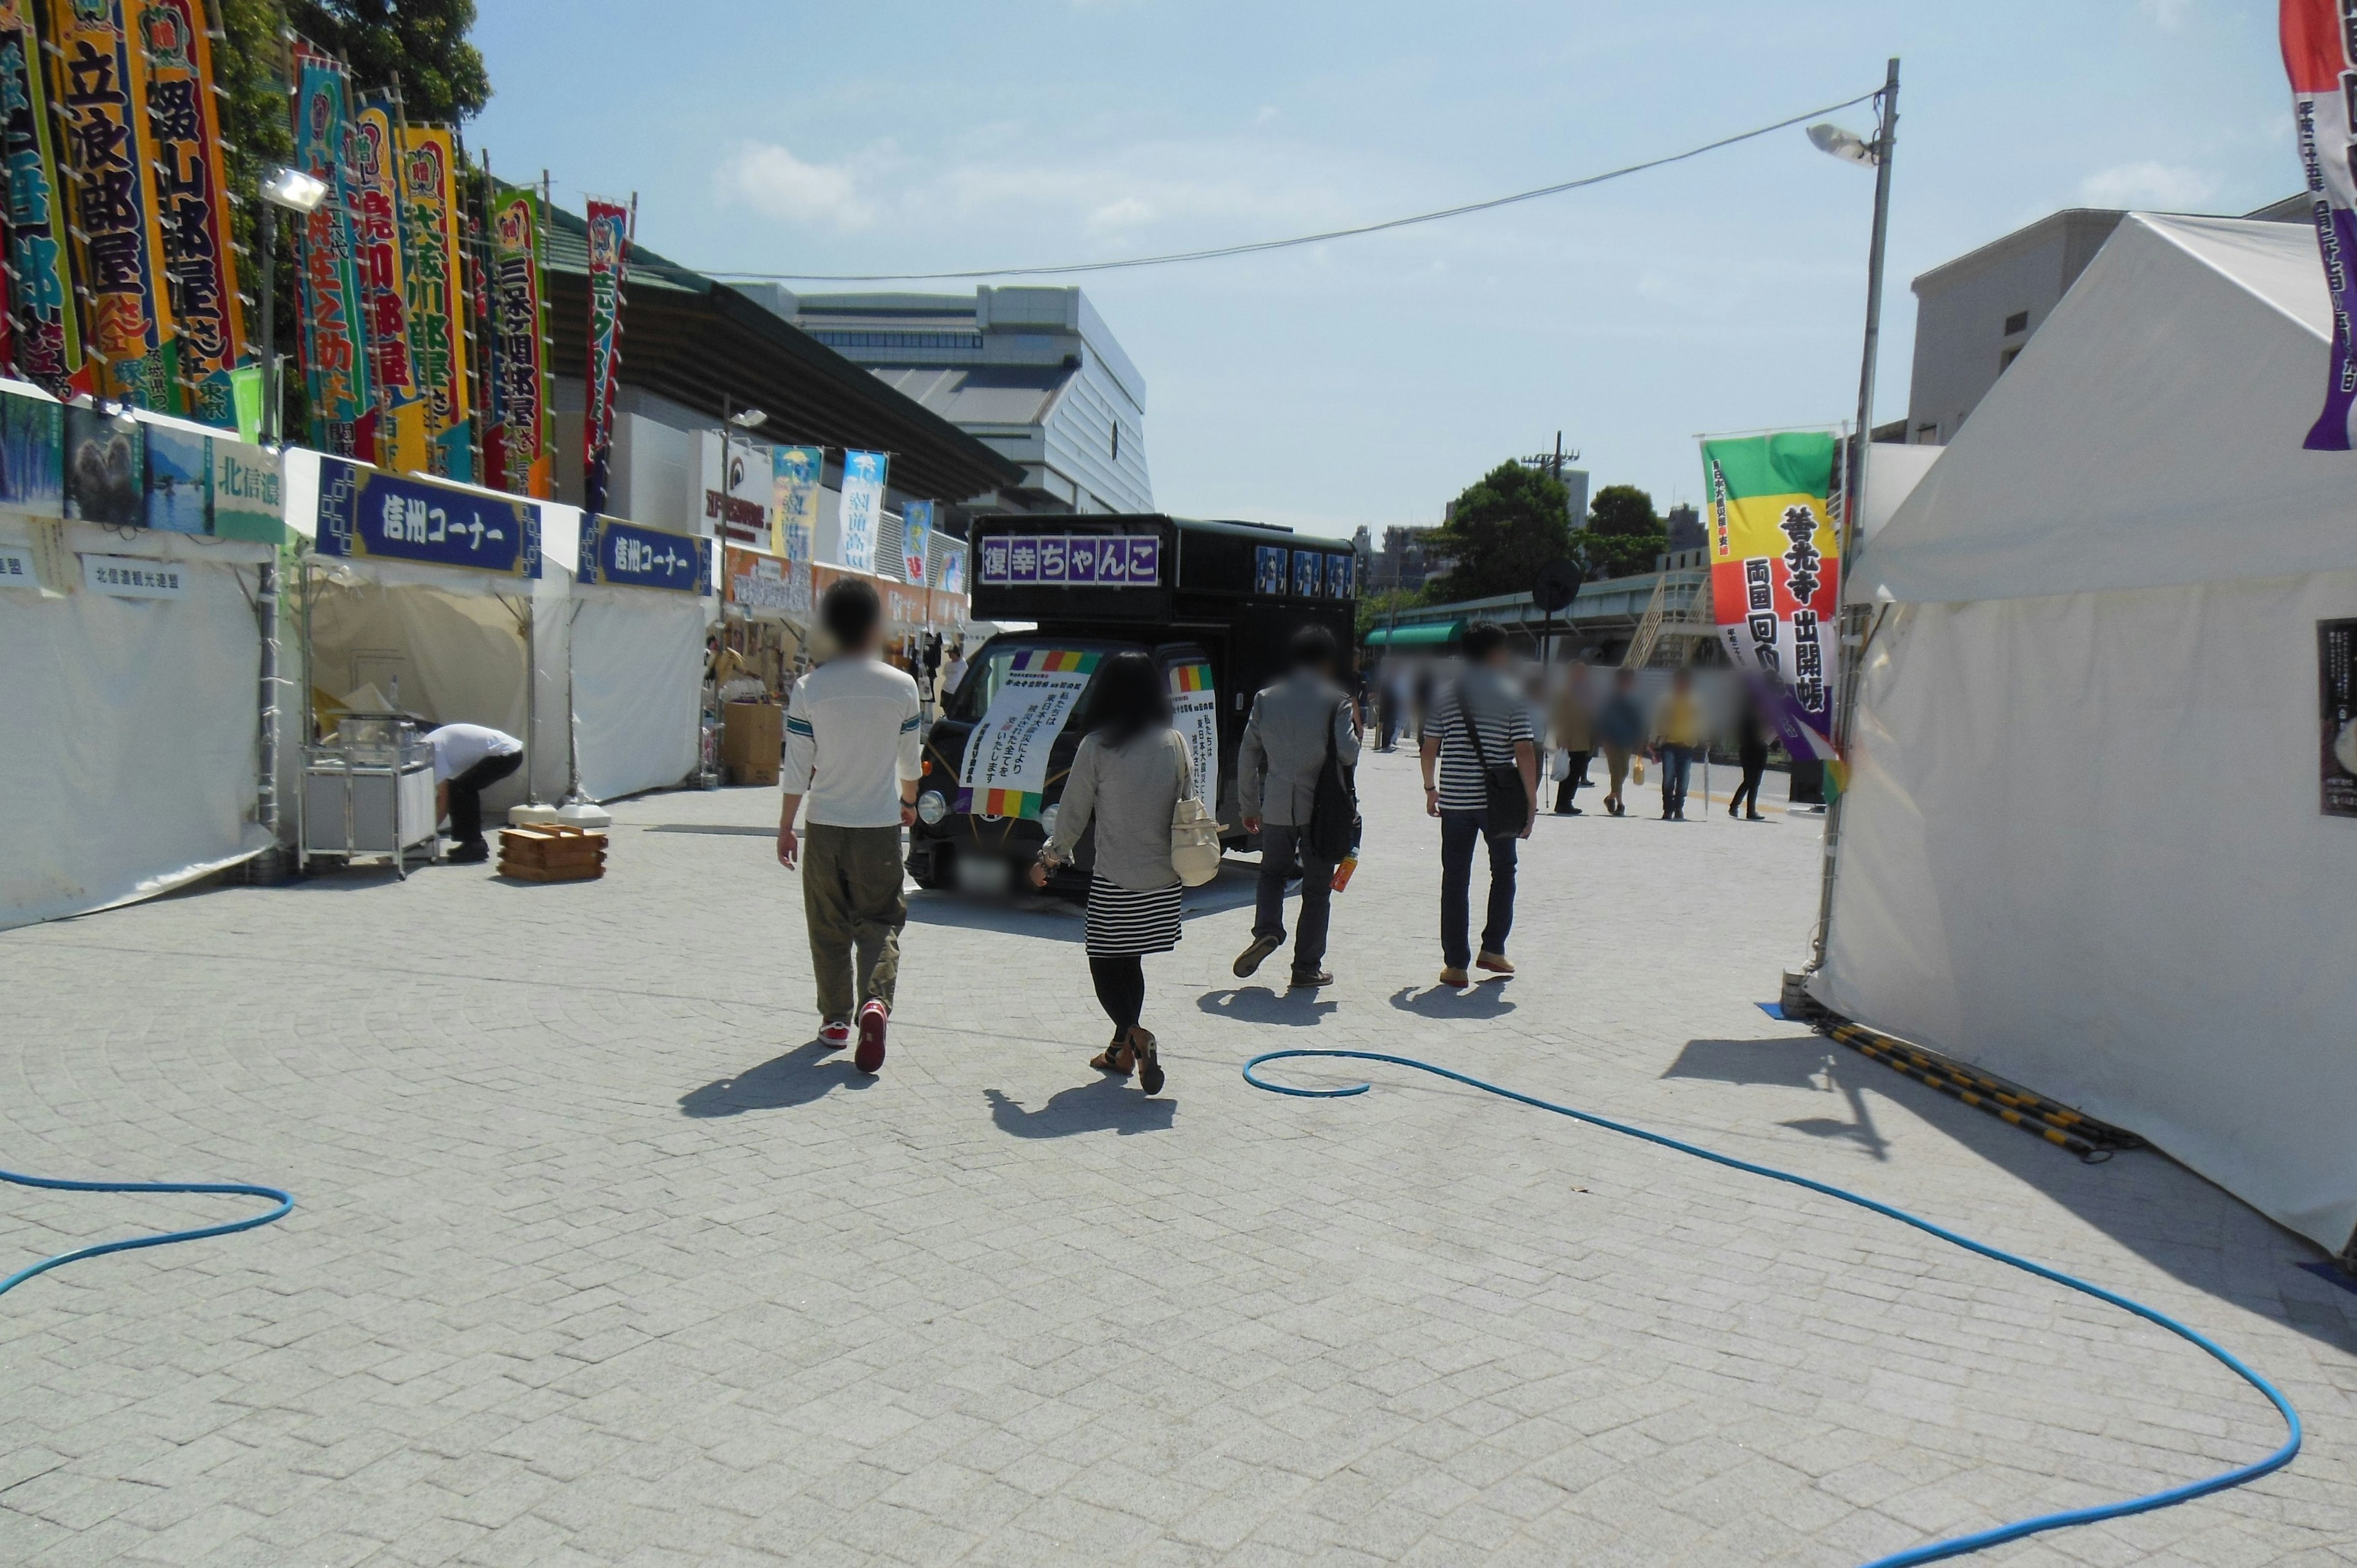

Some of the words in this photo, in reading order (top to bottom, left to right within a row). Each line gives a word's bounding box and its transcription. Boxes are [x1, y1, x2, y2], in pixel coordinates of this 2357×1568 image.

[219, 455, 280, 507] 北信濃
[382, 493, 503, 550] 信州コーナー
[96, 567, 179, 589] 北信濃観光連盟
[614, 536, 687, 576] 信州コーナー
[985, 544, 1155, 576] 復幸ちゃんこ
[1781, 506, 1821, 605] 善光寺
[1745, 558, 1773, 611] 両国
[1792, 609, 1825, 713] 出開帳
[1046, 691, 1069, 726] 私たちは
[1204, 714, 1213, 757] 私たちは
